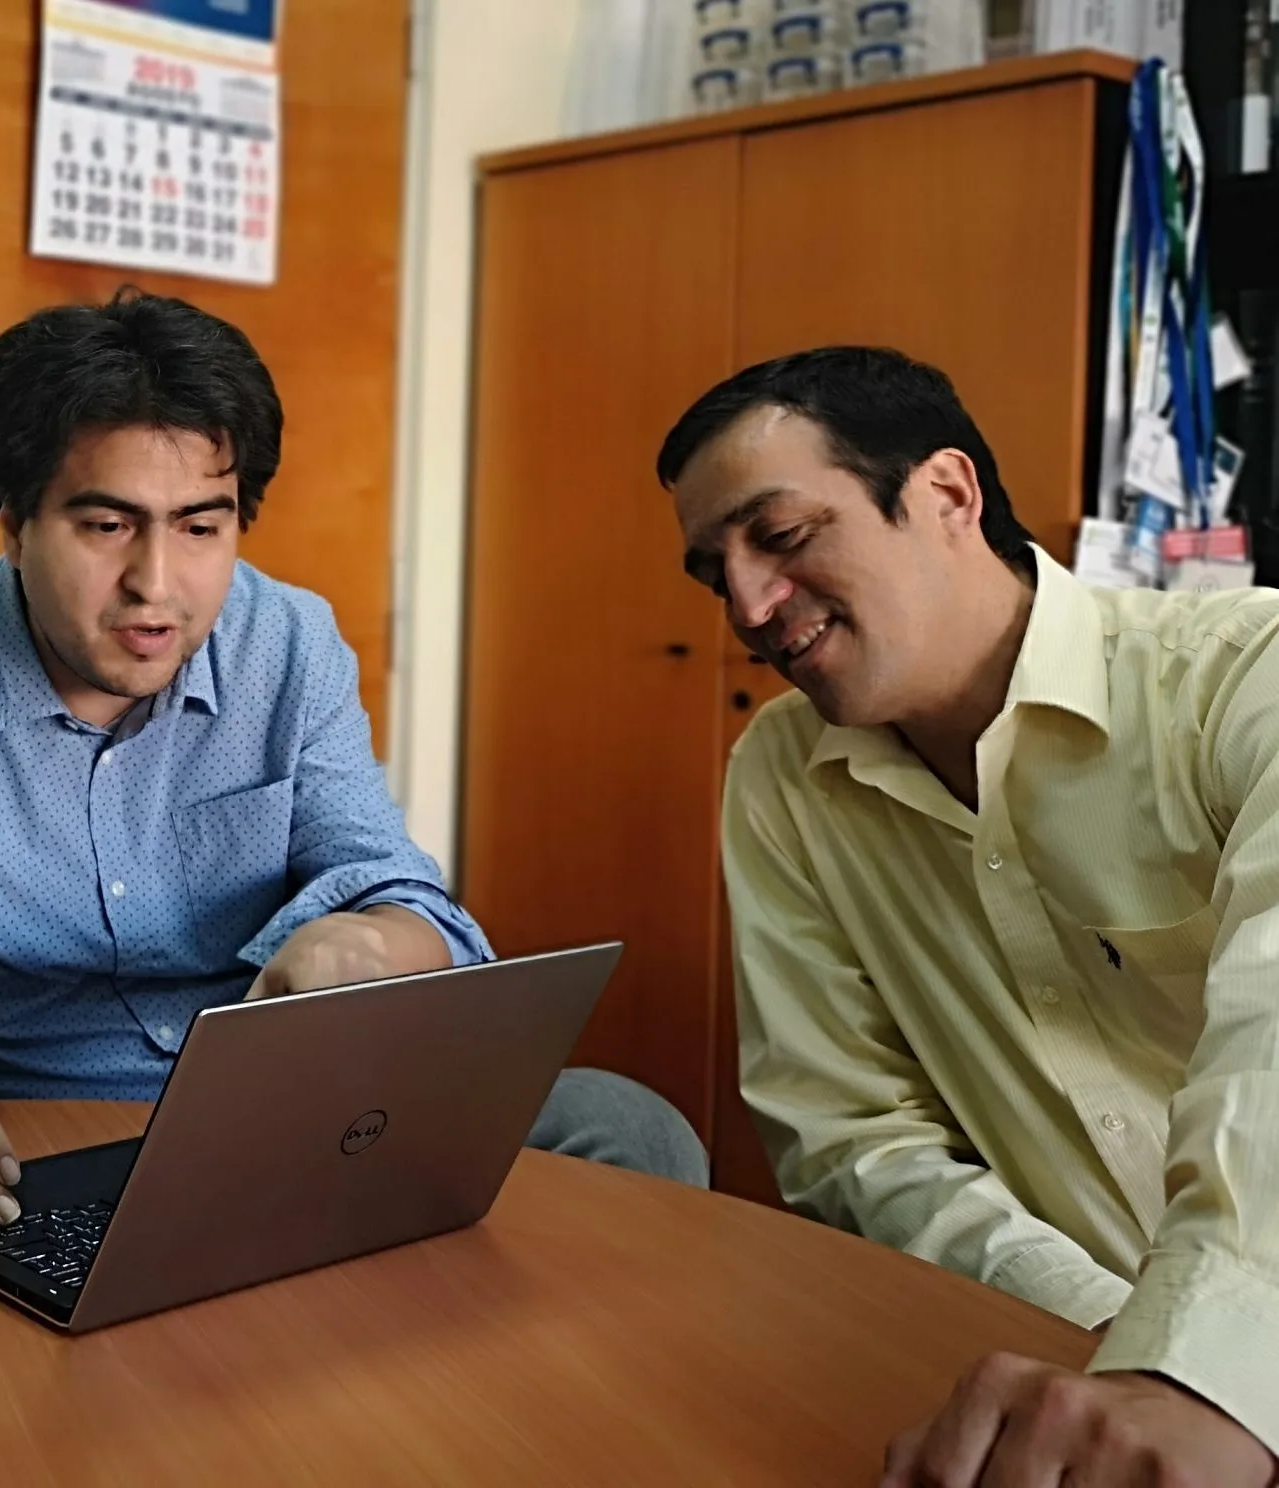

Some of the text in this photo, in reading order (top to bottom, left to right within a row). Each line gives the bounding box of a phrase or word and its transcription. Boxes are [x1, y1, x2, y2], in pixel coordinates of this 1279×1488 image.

[90, 136, 106, 161] 6
[124, 141, 138, 166] 7
[212, 160, 239, 183] 10
[244, 164, 268, 186] 11
[53, 159, 81, 184] 12
[85, 165, 112, 189] 13
[118, 169, 144, 194] 14
[212, 186, 238, 210] 17
[51, 187, 79, 213] 19
[117, 198, 142, 221] 21
[48, 215, 78, 240] 26
[83, 221, 111, 245] 27
[347, 1125, 380, 1140] DELL
